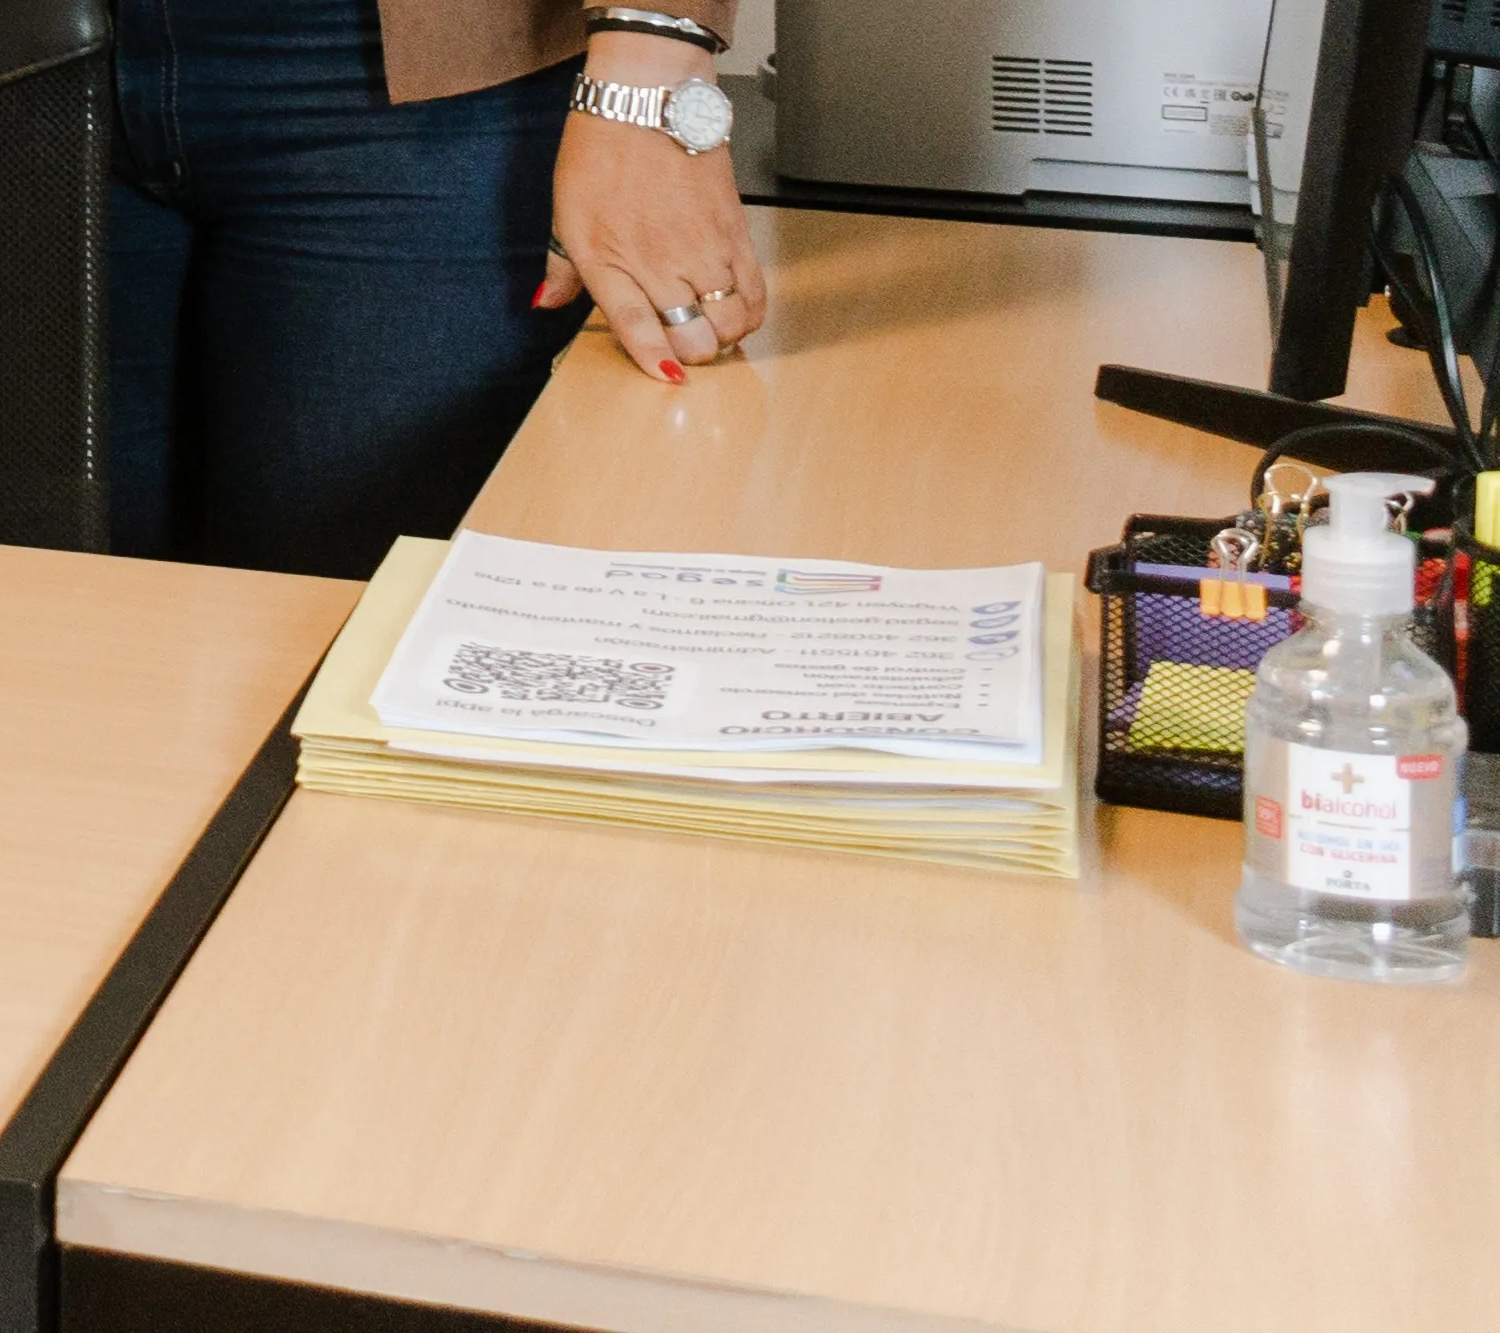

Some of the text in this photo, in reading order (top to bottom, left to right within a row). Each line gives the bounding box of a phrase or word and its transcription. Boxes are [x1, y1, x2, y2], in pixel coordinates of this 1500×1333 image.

[604, 569, 764, 586] segad
[574, 586, 602, 595] de
[629, 622, 644, 631] y
[909, 634, 957, 643] 362
[905, 650, 955, 659] 362
[774, 663, 967, 674] Control de gastos
[863, 682, 963, 691] Contacto
[720, 687, 962, 700] Noticias del consorcio
[501, 706, 522, 716] la
[531, 706, 657, 728] Descargá
[760, 709, 945, 722] ABIERTO
[1400, 760, 1440, 772] NUEVO
[1301, 789, 1397, 820] bialcohol
[1300, 844, 1398, 864] CON GLICERINA
[1325, 877, 1371, 891] PORTA
